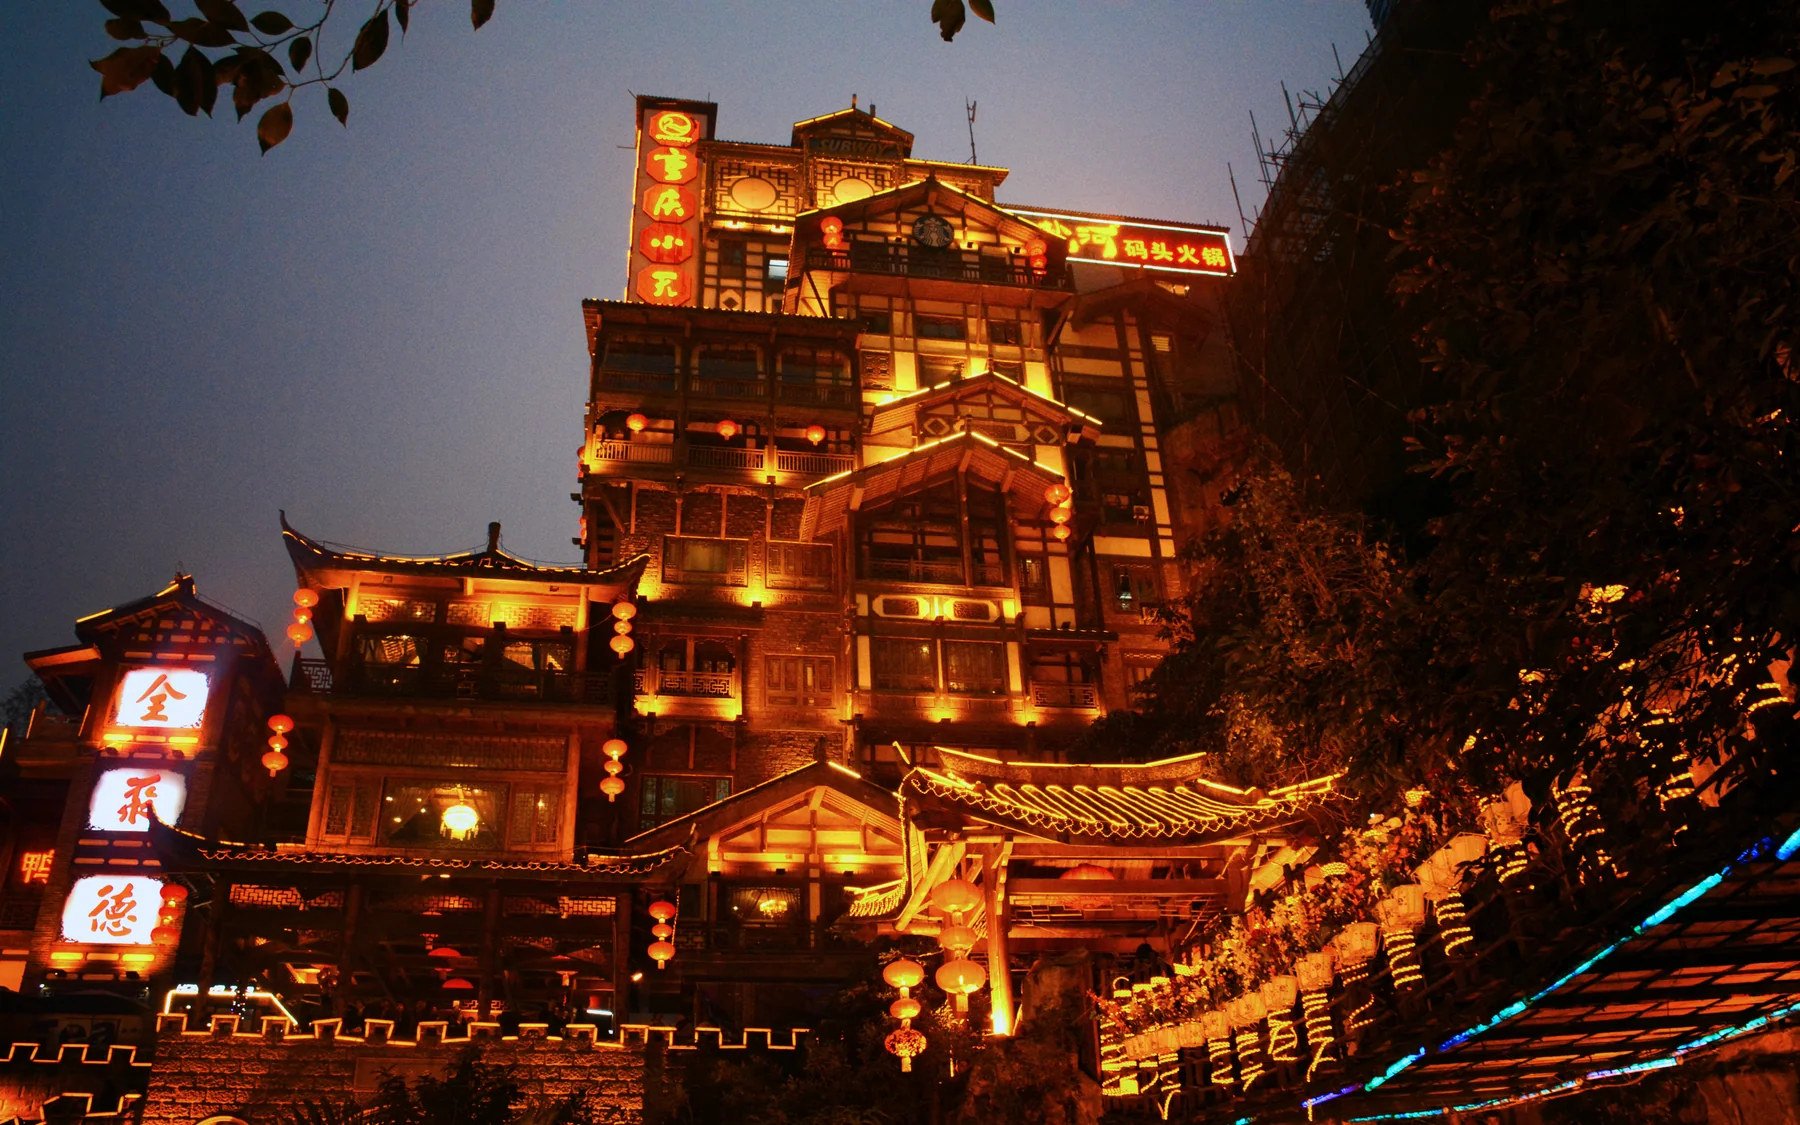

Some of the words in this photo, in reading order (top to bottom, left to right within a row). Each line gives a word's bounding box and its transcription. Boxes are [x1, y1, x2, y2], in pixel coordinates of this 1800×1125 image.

[819, 138, 889, 156] SUBWAY
[1123, 239, 1227, 267] 码头火锅
